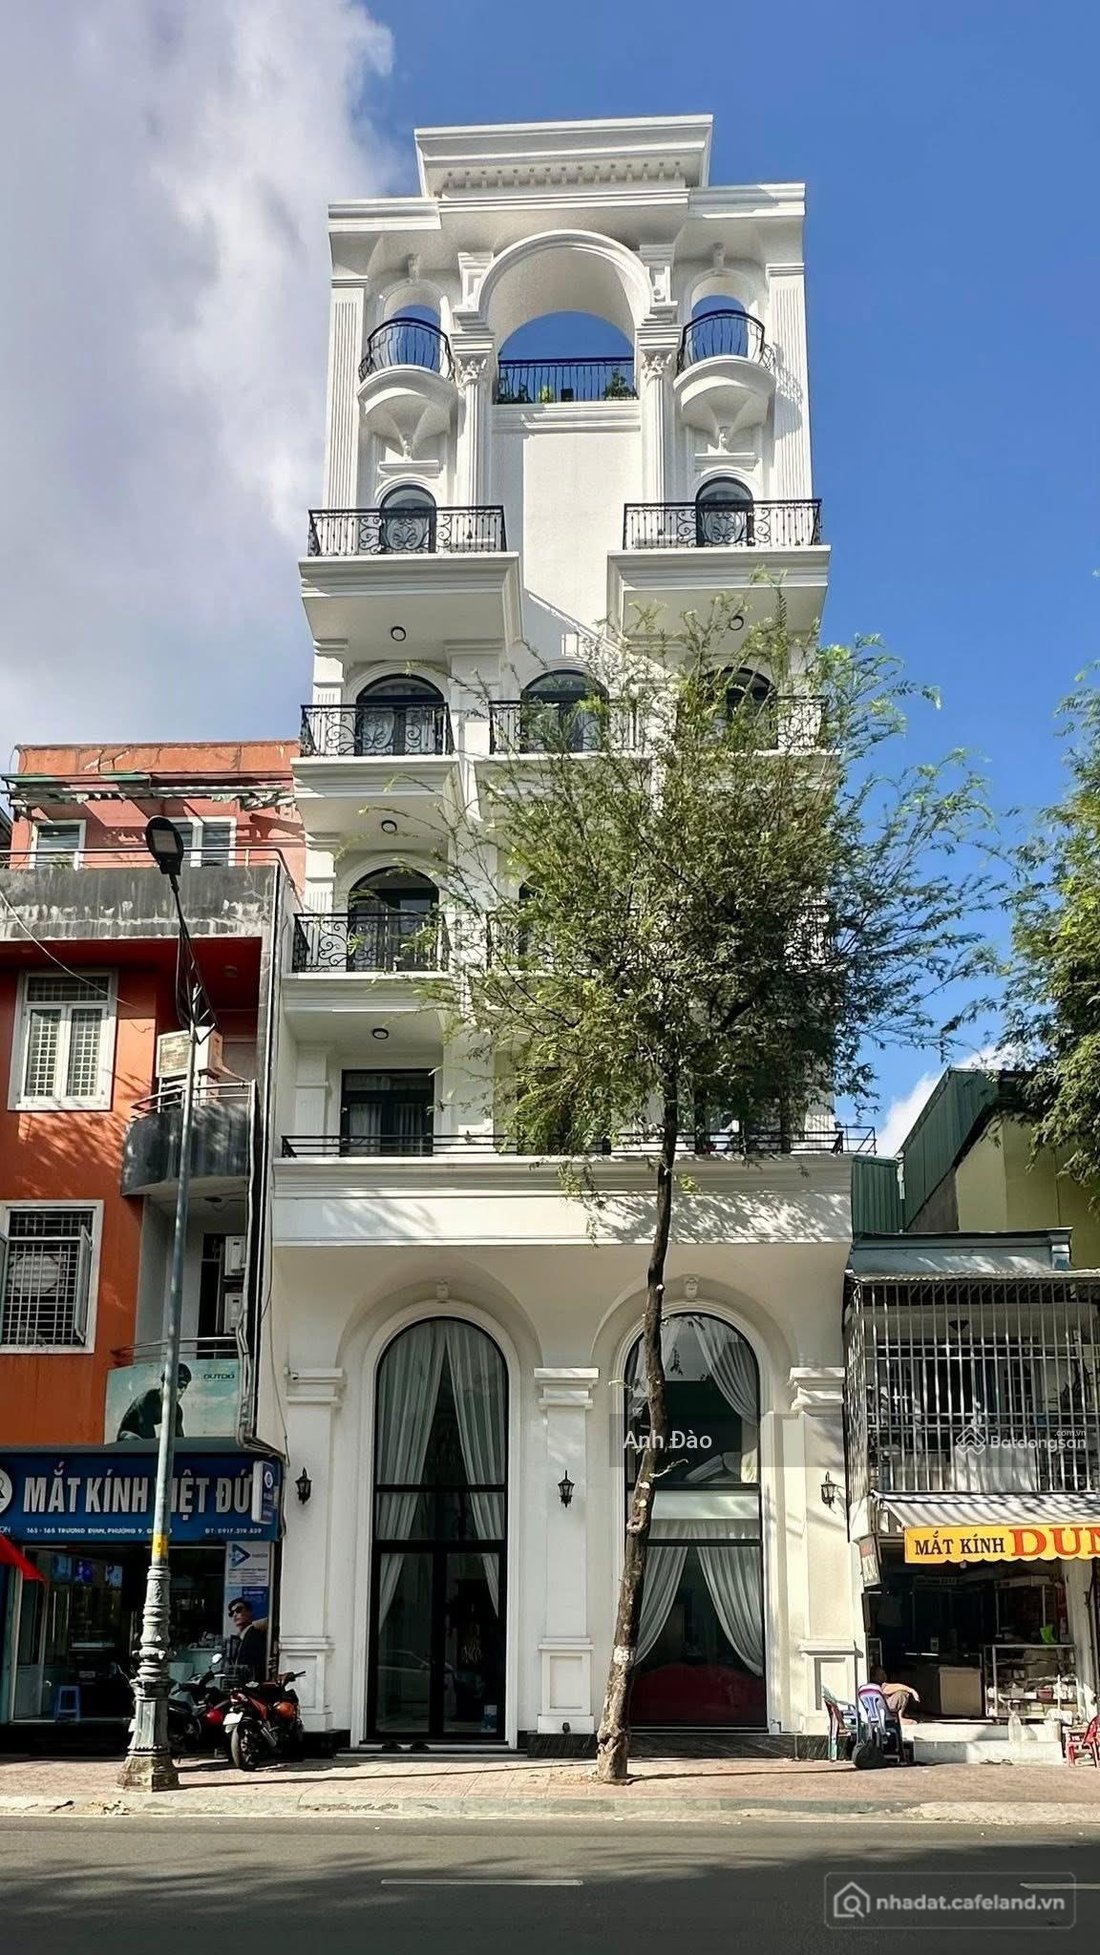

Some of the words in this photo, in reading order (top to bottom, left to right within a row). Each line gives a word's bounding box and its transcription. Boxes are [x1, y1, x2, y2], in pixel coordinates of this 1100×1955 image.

[23, 1461, 81, 1513] MẮT
[85, 1468, 149, 1513] KÍNH
[155, 1469, 210, 1521] IỆT
[215, 1468, 254, 1514] ĐỨ
[914, 1531, 954, 1555] MẮT
[959, 1534, 1005, 1554] KÍNH
